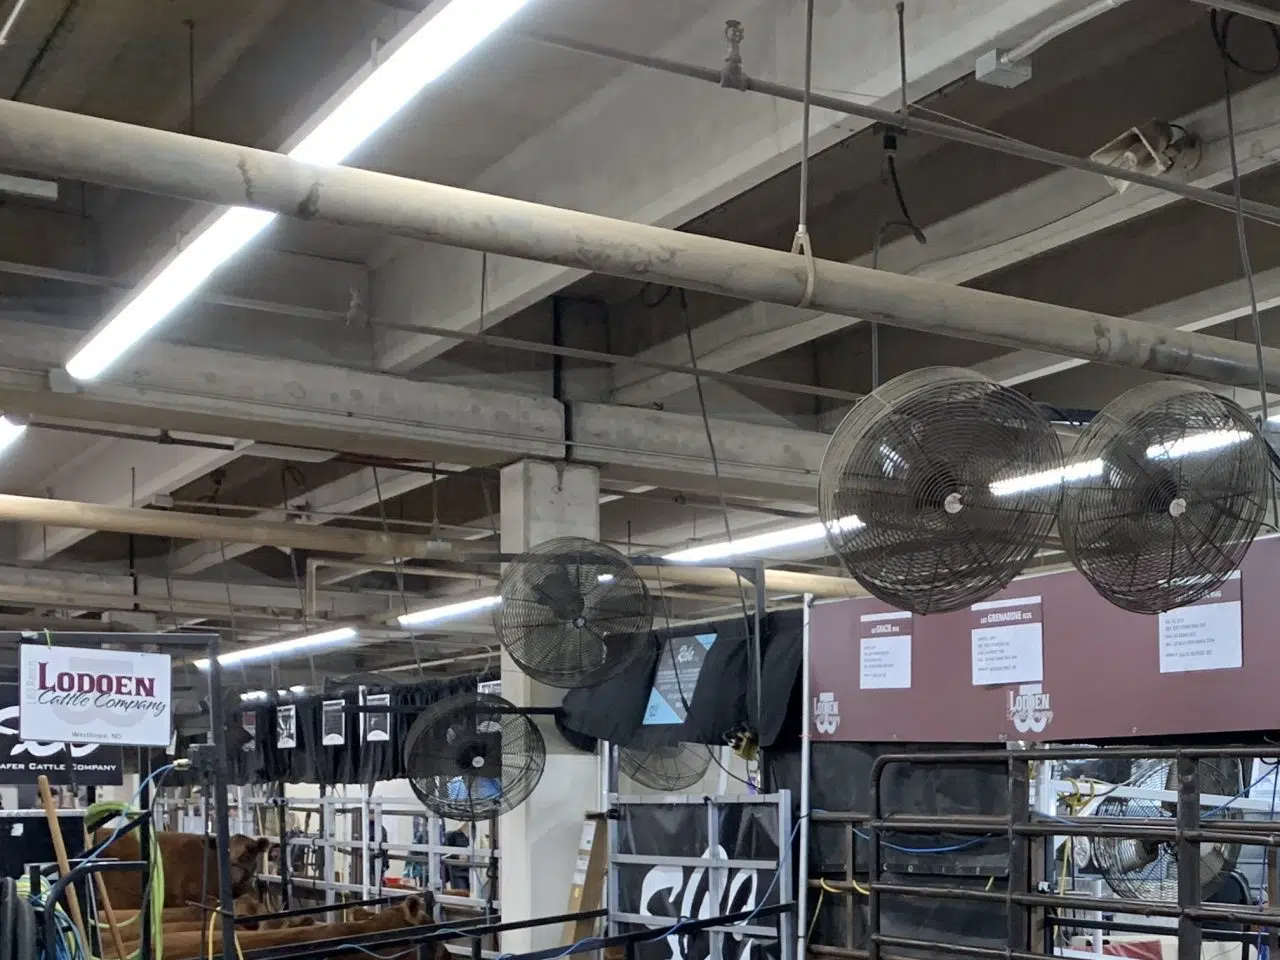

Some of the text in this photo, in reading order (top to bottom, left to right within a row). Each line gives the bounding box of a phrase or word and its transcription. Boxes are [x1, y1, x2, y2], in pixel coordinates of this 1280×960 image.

[38, 661, 156, 698] LODOEN
[38, 689, 166, 717] Cattle Company
[28, 762, 66, 770] CATTLE
